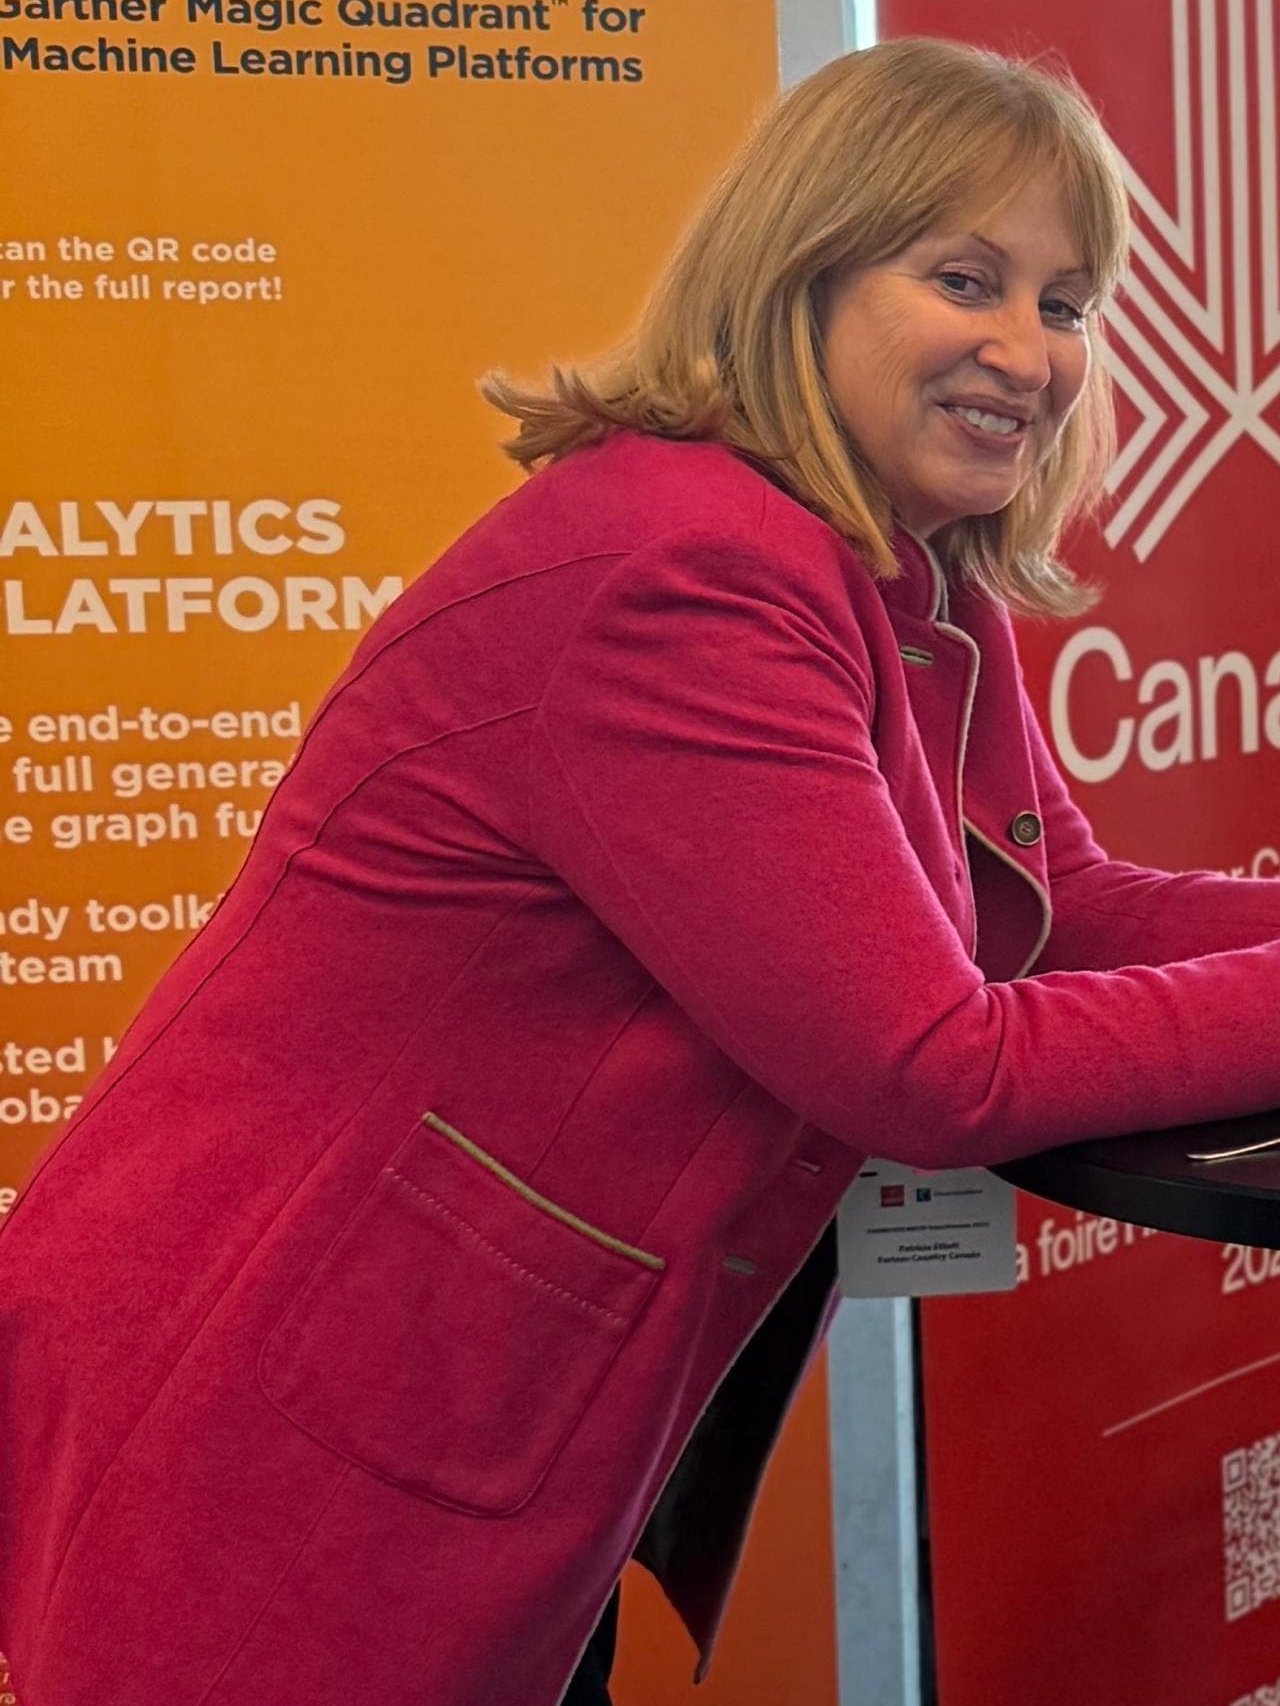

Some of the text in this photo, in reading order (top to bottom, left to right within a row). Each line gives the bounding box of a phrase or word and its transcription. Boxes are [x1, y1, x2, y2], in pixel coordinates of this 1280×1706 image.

[2, 36, 643, 84] Machine Learning Platforms
[57, 236, 115, 261] the
[127, 237, 180, 263] QR
[192, 238, 277, 263] code
[26, 274, 84, 299] the
[95, 274, 150, 299] full
[162, 276, 283, 304] report!
[0, 499, 346, 557] ALYTICS
[0, 575, 404, 635] LATFORM
[28, 701, 300, 743] end-to-end
[13, 756, 94, 794] full
[51, 804, 198, 848] graph
[0, 951, 123, 985] team
